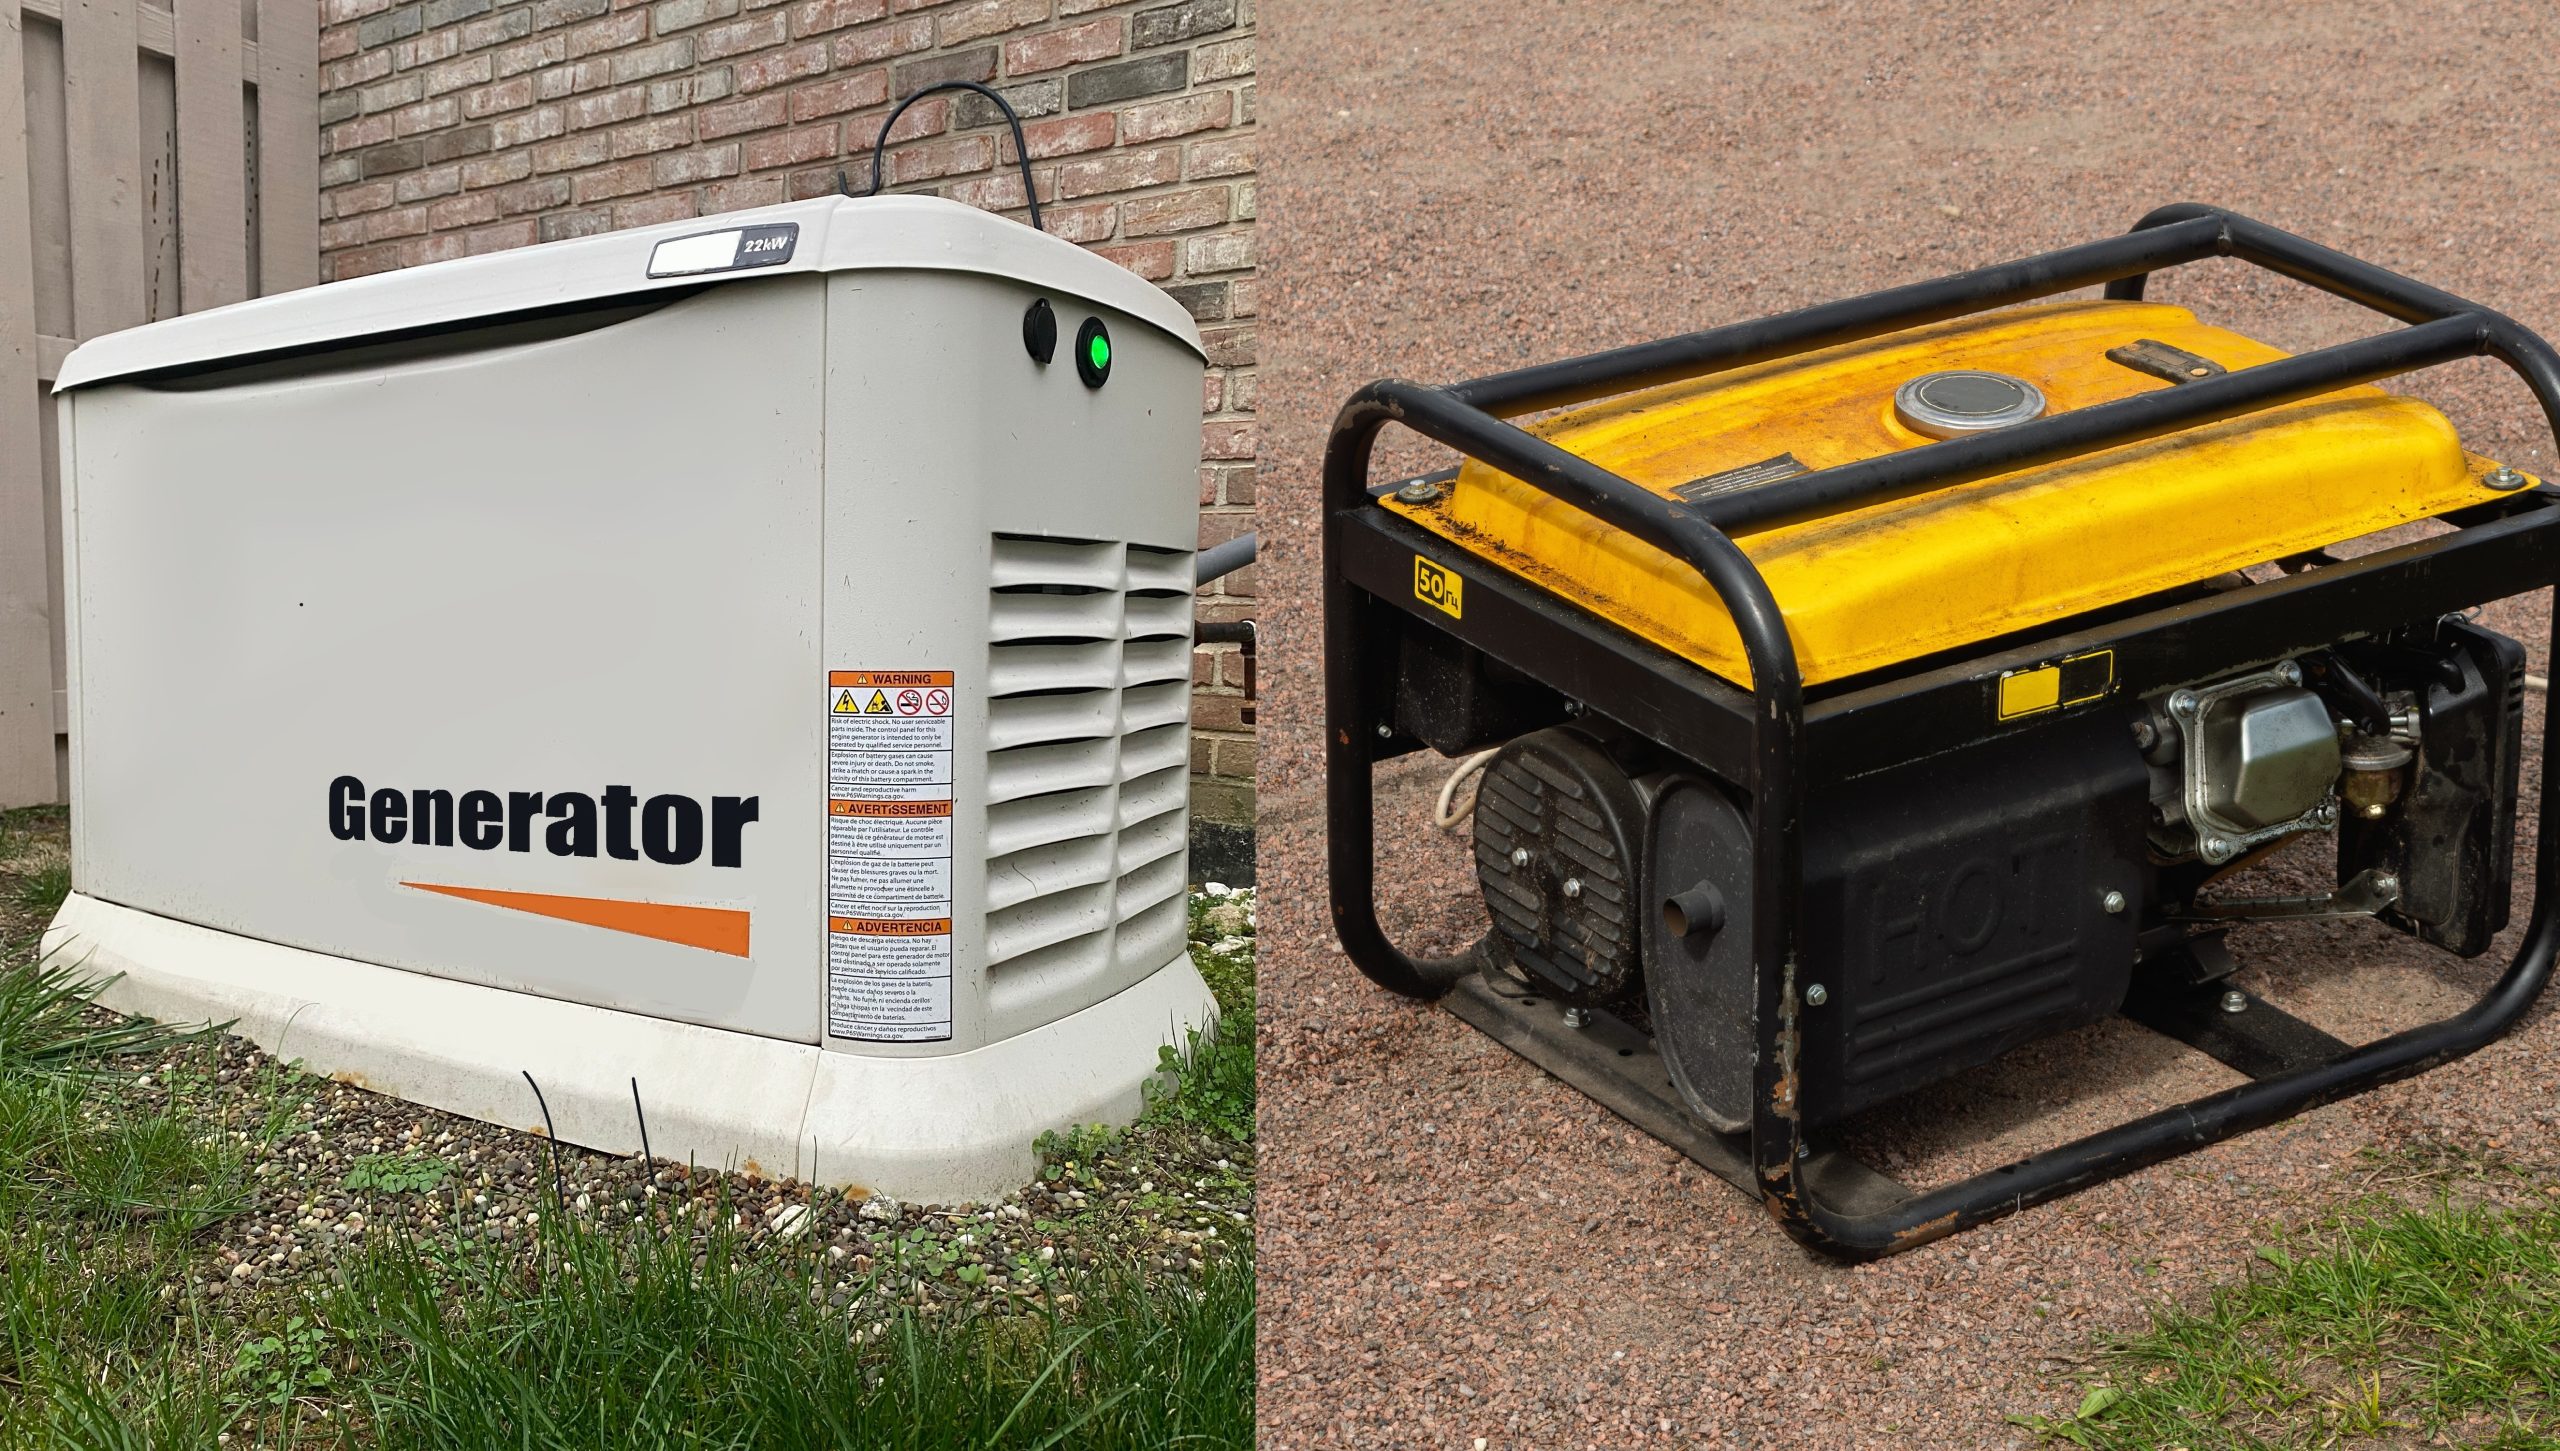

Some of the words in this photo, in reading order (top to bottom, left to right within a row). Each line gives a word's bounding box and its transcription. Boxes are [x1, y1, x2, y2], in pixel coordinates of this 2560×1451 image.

[744, 236, 788, 253] 22kW
[1419, 567, 1444, 599] 50
[1446, 591, 1459, 611] Гц
[873, 675, 931, 684] WARNING
[866, 752, 887, 760] battery
[848, 803, 948, 814] AVERTISSEMENT
[328, 775, 759, 868] Generator
[1871, 832, 2070, 984] HOT
[857, 922, 942, 933] ADVERTENCIA
[831, 934, 849, 942] Riesgo
[858, 936, 884, 944] descarga
